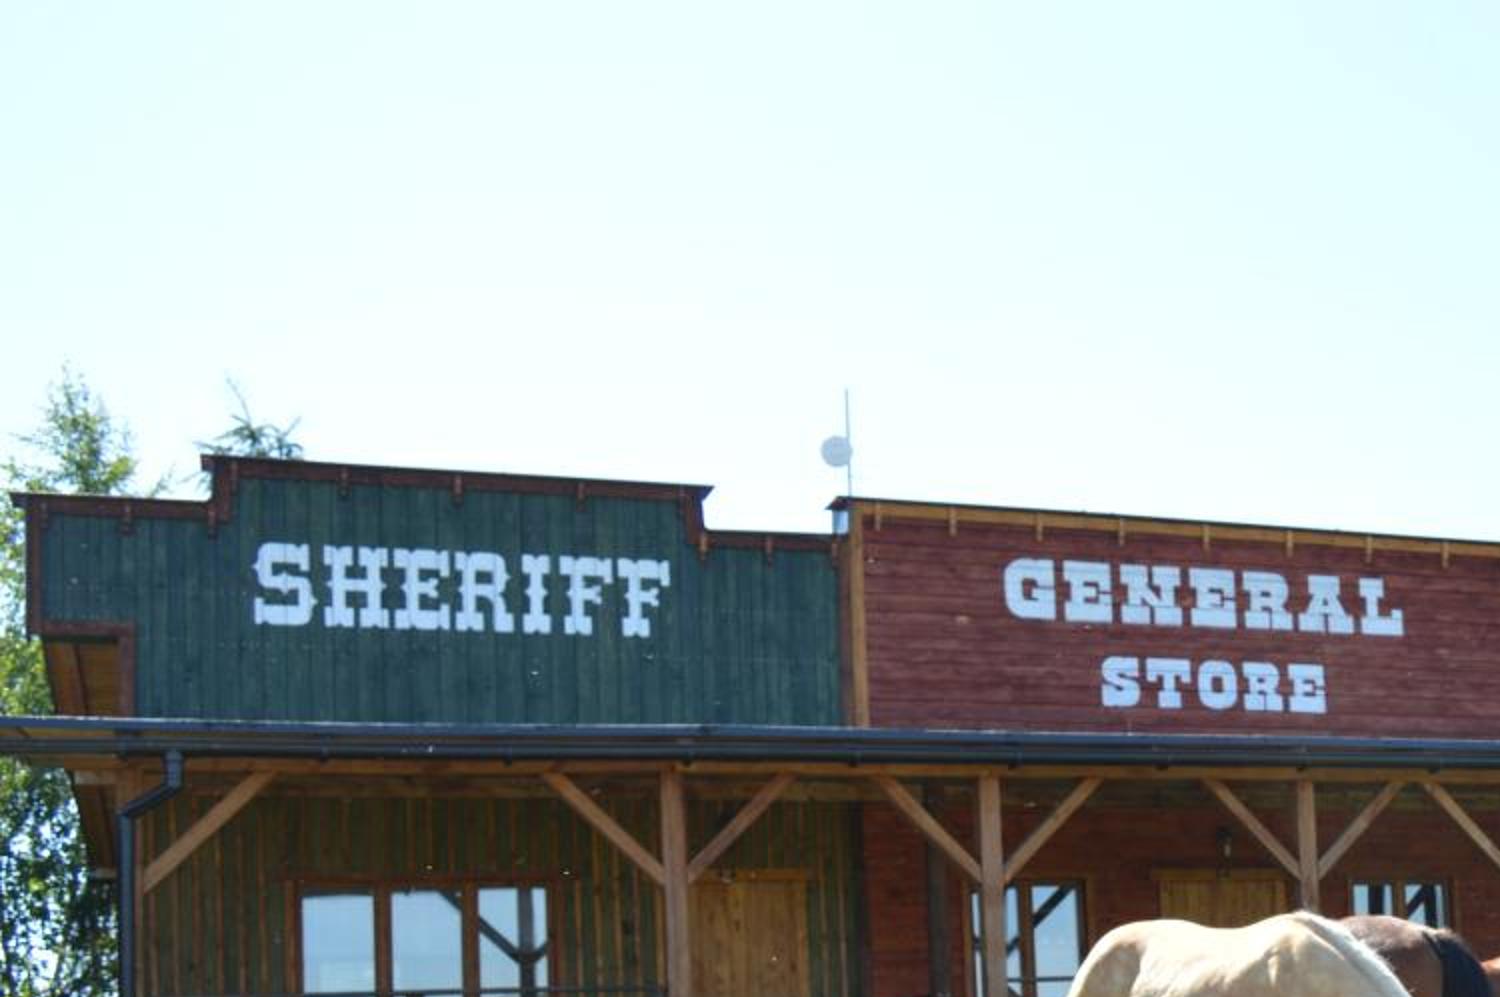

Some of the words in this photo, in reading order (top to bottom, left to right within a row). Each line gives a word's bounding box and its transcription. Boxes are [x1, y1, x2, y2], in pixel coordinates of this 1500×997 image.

[253, 541, 670, 638] SHERIFF
[1003, 556, 1405, 637] GENERAL
[1100, 655, 1328, 714] STORE
